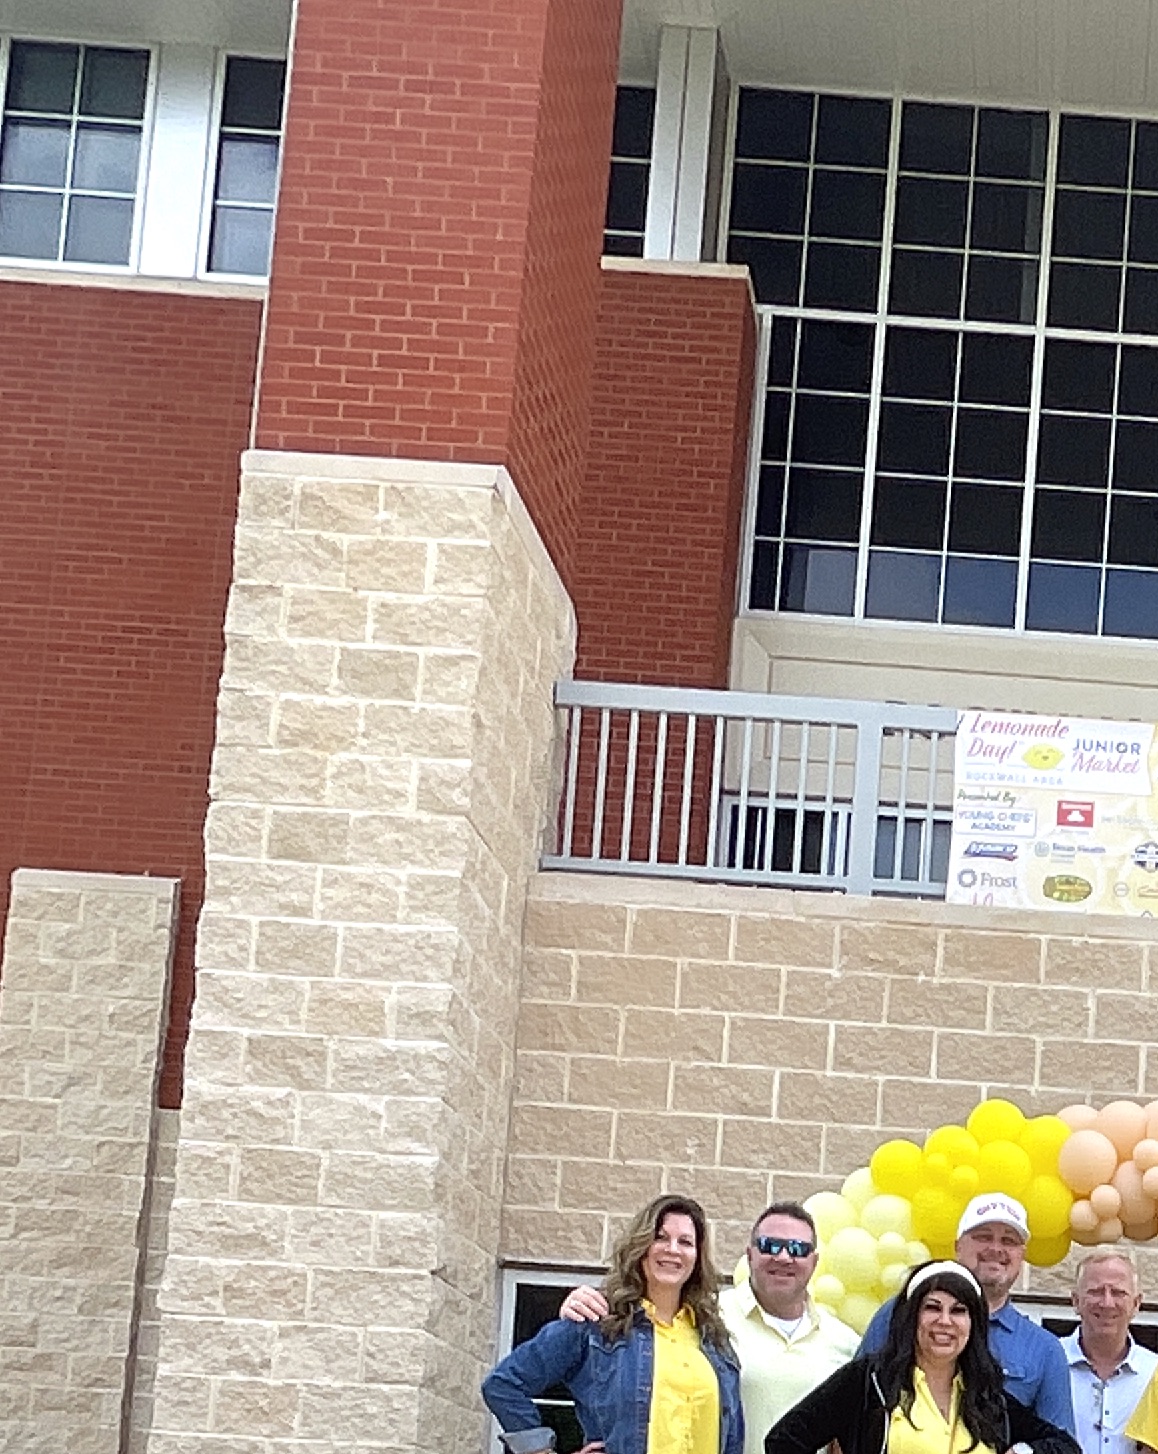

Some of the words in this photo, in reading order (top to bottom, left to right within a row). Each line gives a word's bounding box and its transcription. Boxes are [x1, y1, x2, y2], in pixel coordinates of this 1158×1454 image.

[970, 713, 1069, 739] Lemonade
[967, 737, 1016, 763] Day!
[1073, 738, 1141, 755] JUNIOR
[1071, 752, 1141, 774] Market
[966, 771, 1026, 784] ROCKWALL
[1033, 774, 1064, 786] AREA
[980, 872, 1018, 889] Frost
